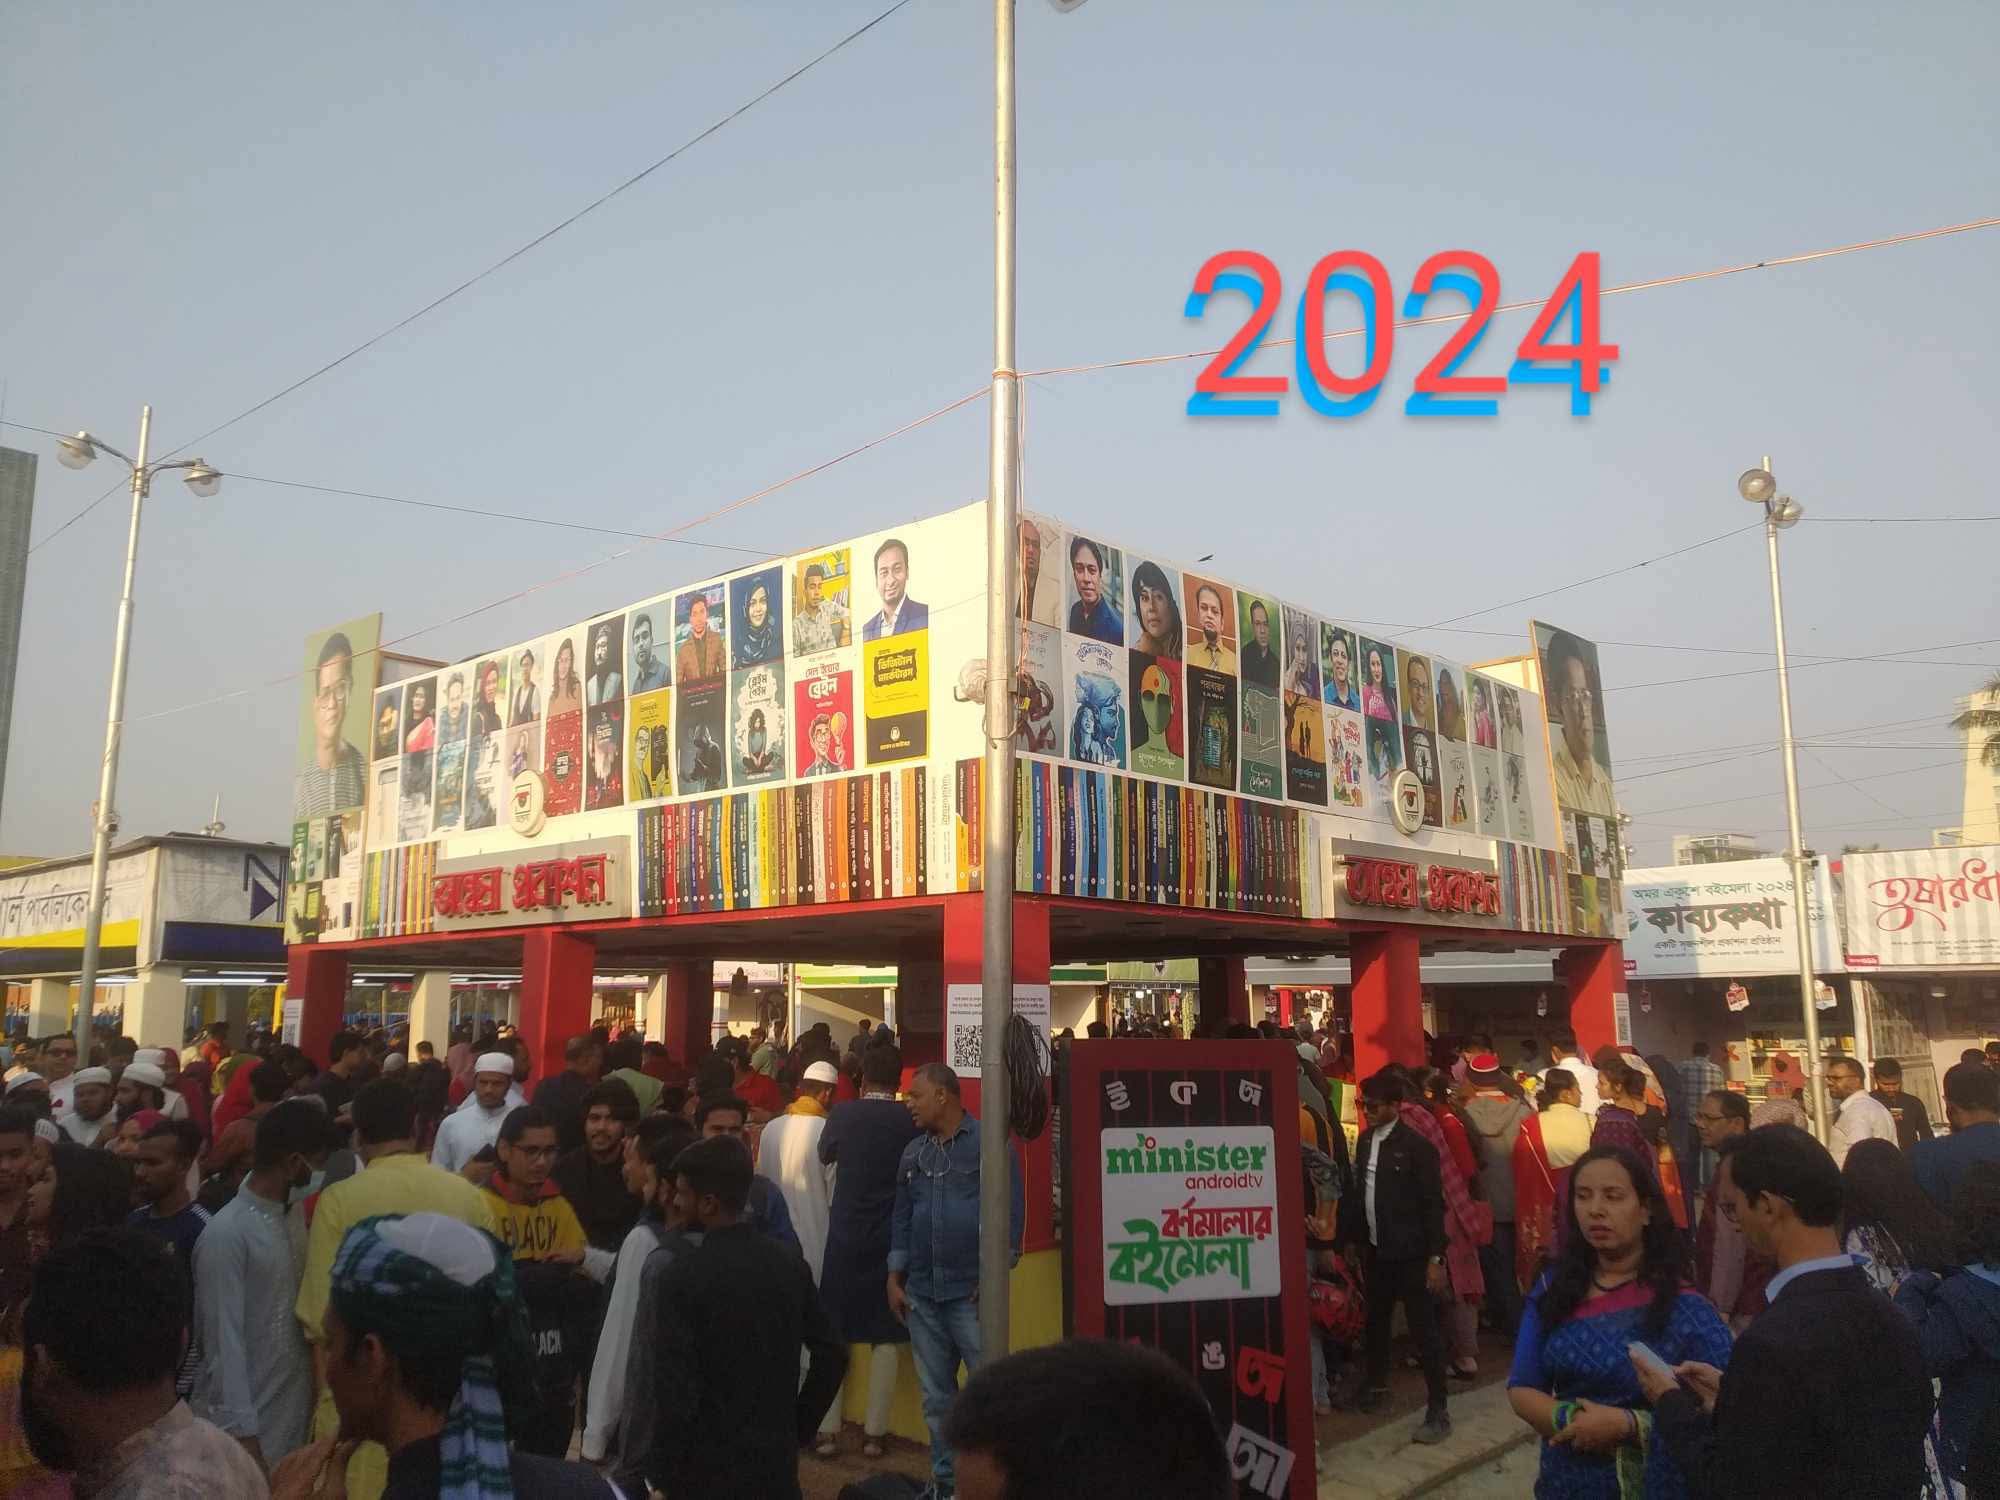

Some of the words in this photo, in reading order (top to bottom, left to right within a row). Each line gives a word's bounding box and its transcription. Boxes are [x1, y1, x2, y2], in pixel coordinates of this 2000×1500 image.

[512, 853, 607, 910] প্রকাশন
[1427, 863, 1501, 918] প্রকাশন
[1632, 887, 1660, 900] অমর
[1663, 886, 1700, 901] একুশে
[1704, 882, 1752, 896] বইমেলা
[1756, 880, 1794, 893] ২০২৪
[1642, 896, 1788, 934] কাব্যকথা
[1106, 1134, 1267, 1174] minister
[1161, 1196, 1274, 1241] বর্ণমালার
[1107, 1218, 1255, 1294] বইমেলা
